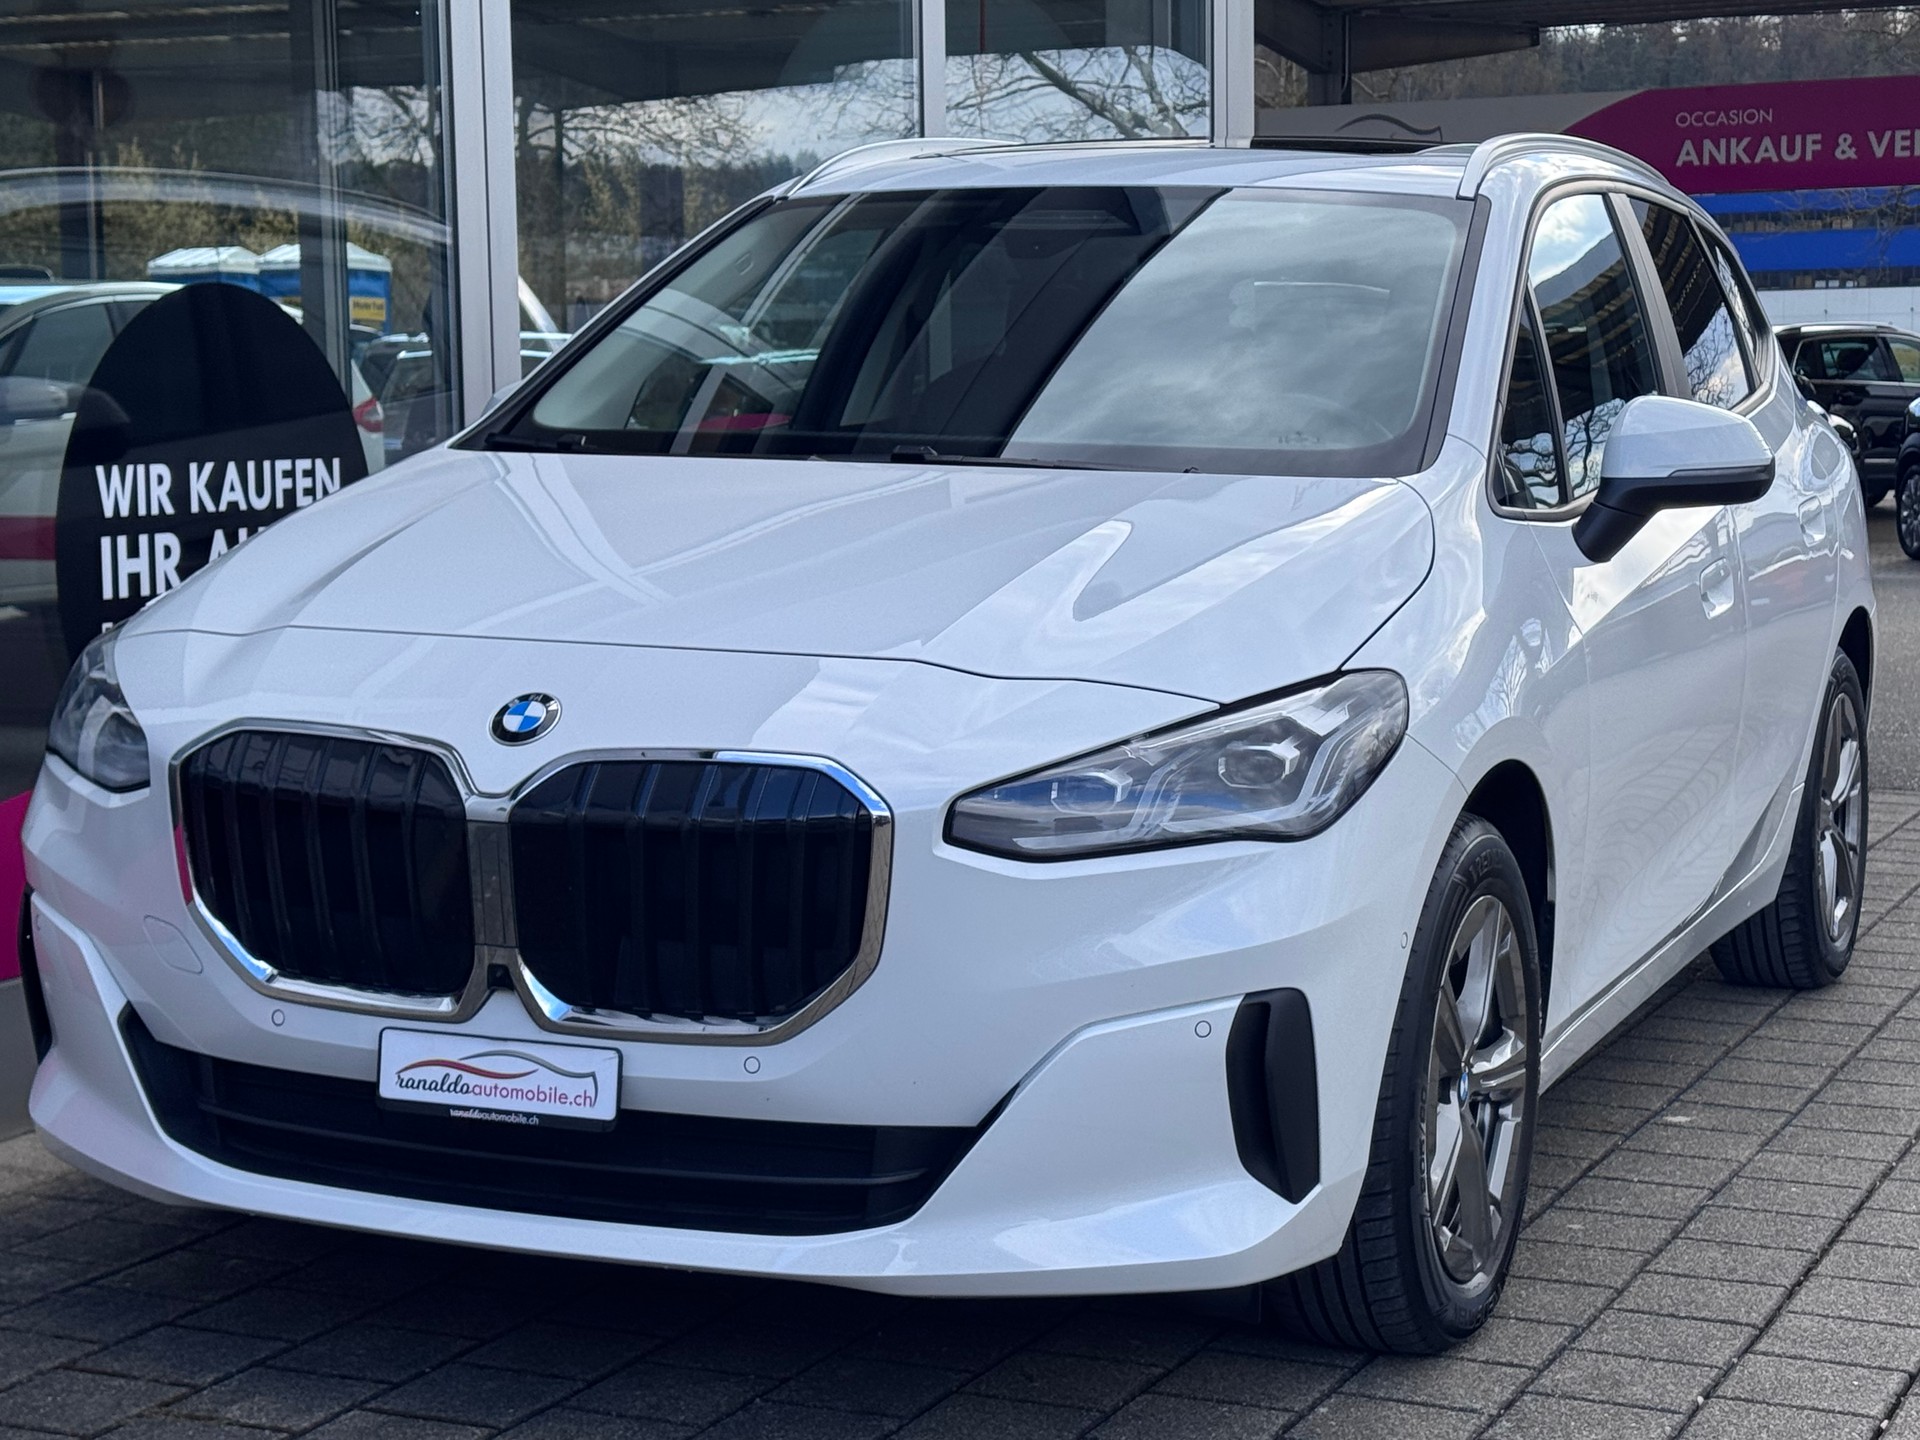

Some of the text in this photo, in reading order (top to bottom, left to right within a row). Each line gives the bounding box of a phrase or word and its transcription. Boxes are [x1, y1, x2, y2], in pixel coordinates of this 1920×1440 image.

[1675, 108, 1773, 128] OCCASION
[1675, 133, 1822, 167] ANKAUF
[1834, 133, 1858, 160] &
[95, 457, 341, 519] WIR KAUFEN
[101, 532, 182, 601] IHR
[395, 1072, 593, 1108] ranaldoautomobile.ch
